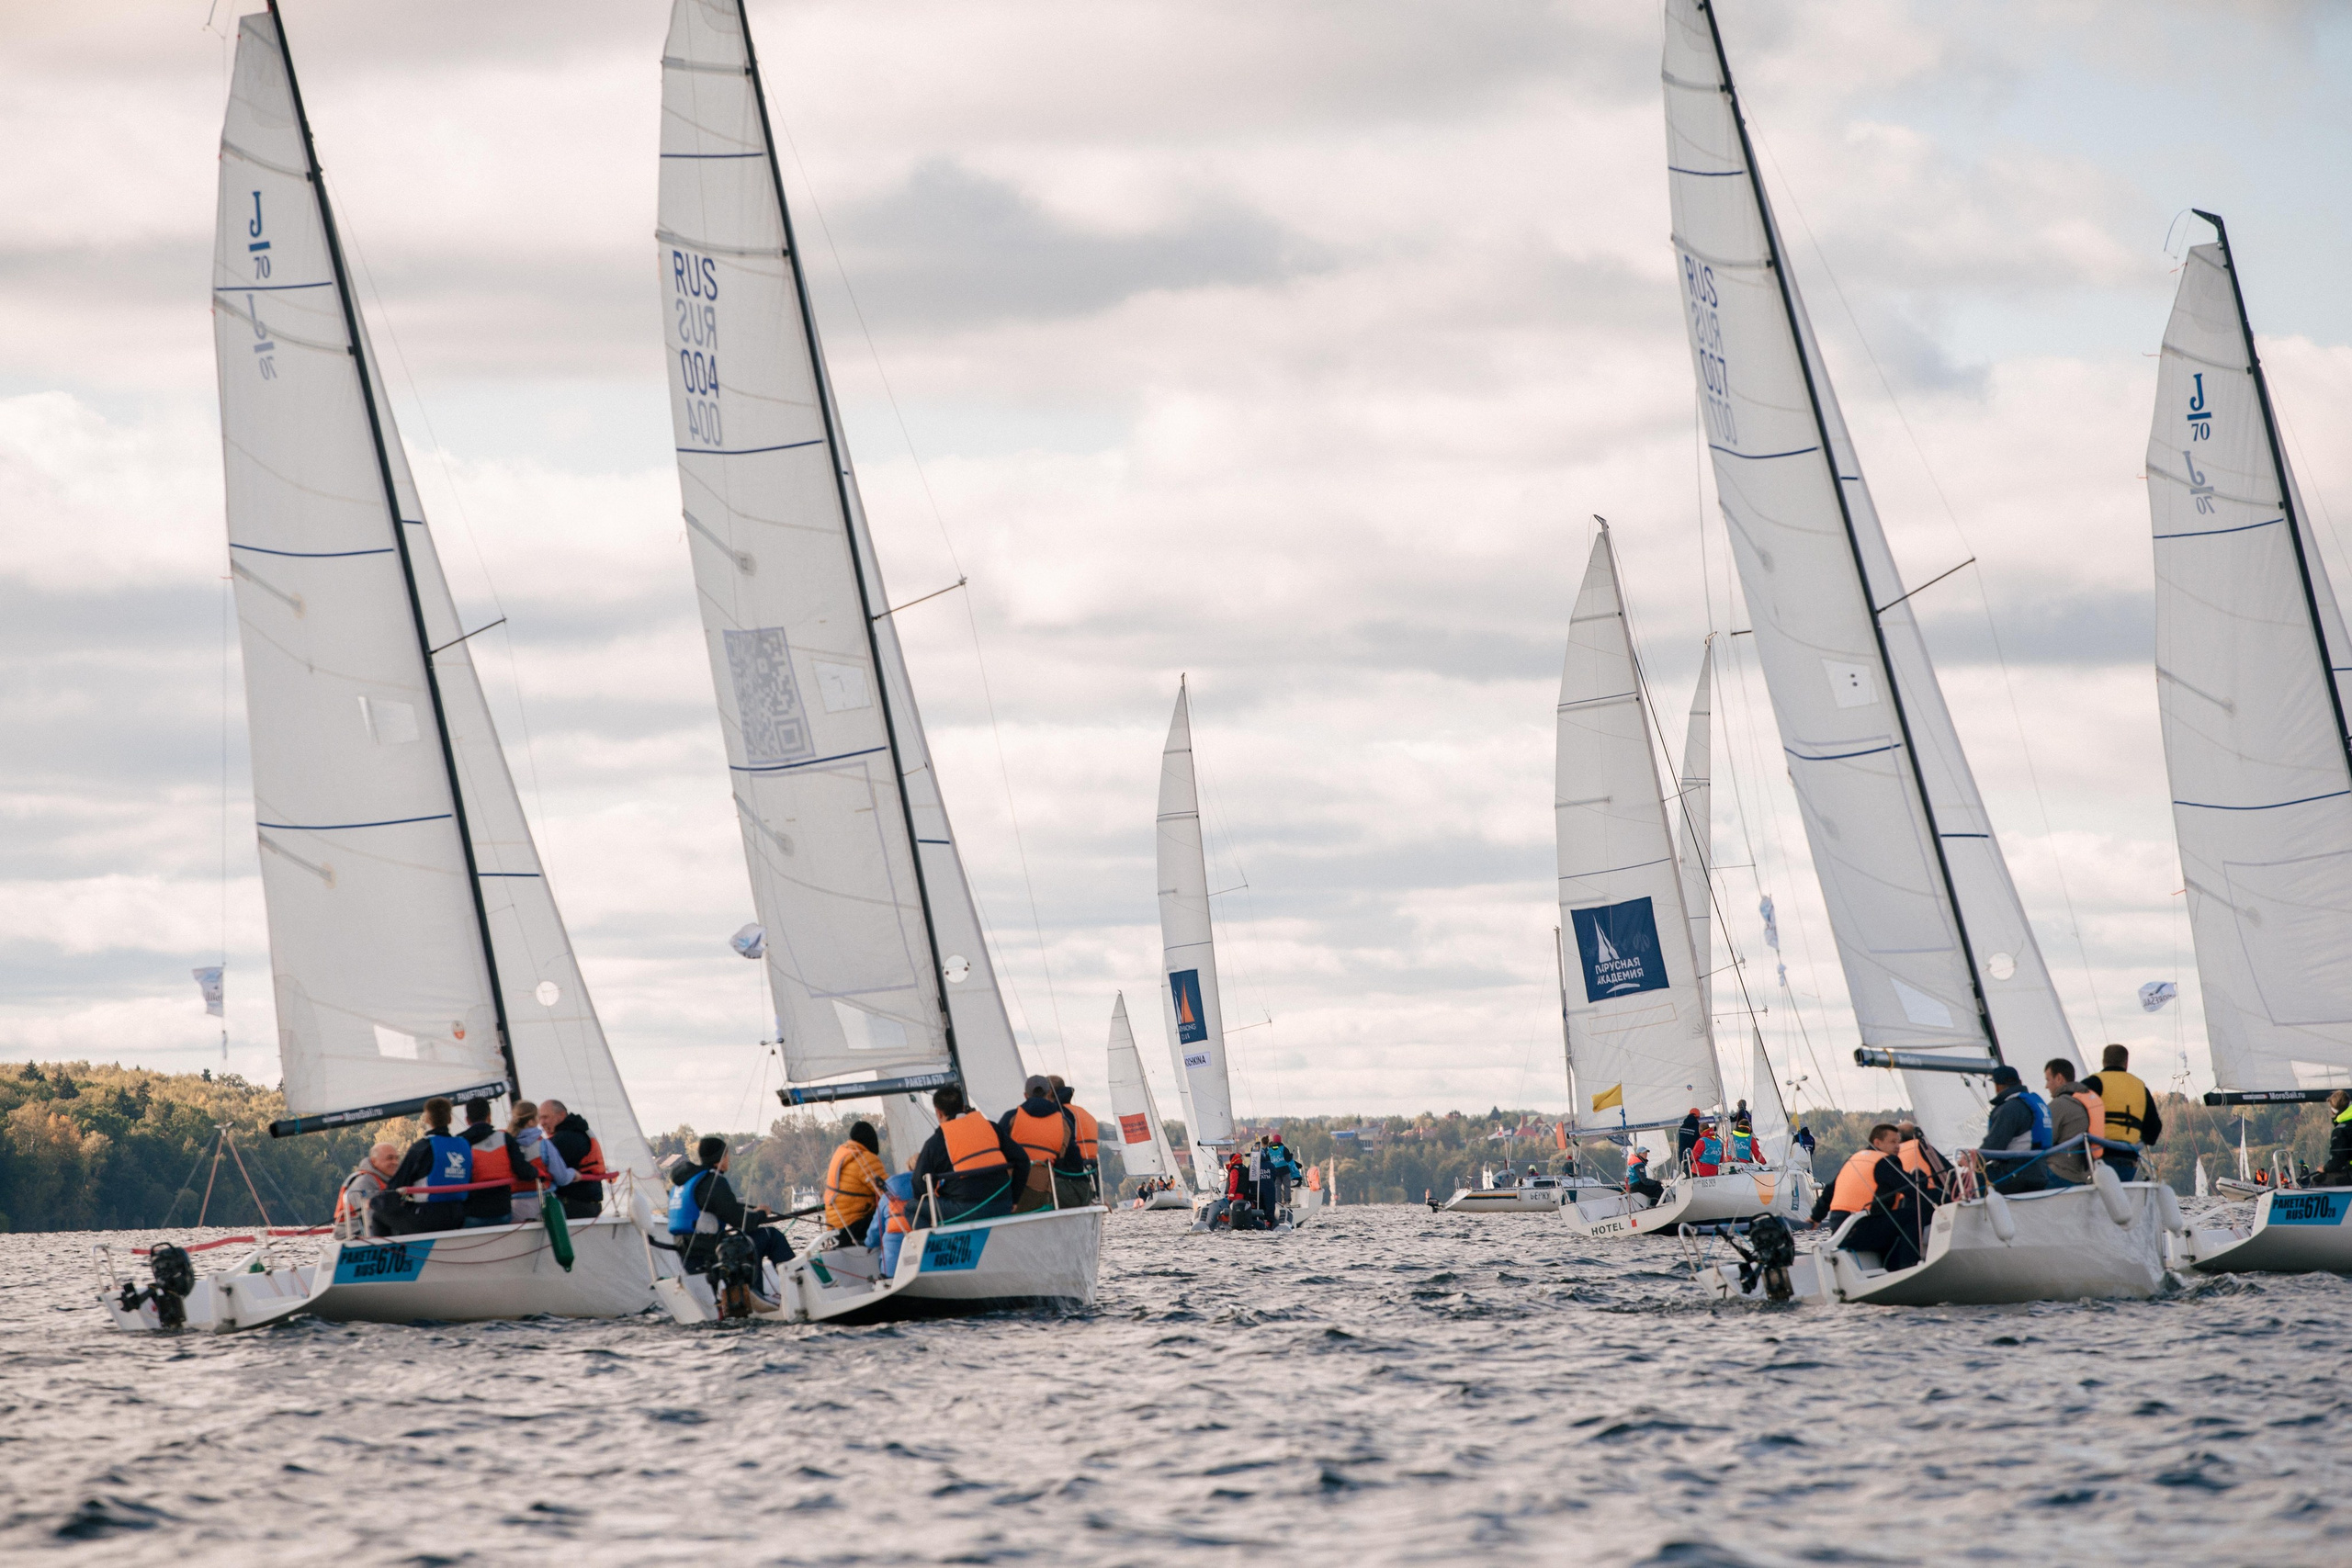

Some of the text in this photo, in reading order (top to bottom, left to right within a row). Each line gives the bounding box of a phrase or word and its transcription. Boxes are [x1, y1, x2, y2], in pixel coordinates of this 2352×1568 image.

[250, 191, 262, 238] J
[254, 255, 271, 280] 70
[673, 250, 718, 301] RUS
[1684, 254, 1718, 309] RUS
[680, 349, 719, 399] 004
[2189, 372, 2204, 412] J
[2191, 422, 2211, 442] 70
[1597, 967, 1645, 986] АКАДЕМИЯ
[2268, 1091, 2306, 1100] MoreSail.ru
[2285, 1209, 2304, 1221] RUS
[2304, 1195, 2329, 1219] 670
[1591, 1222, 1624, 1236] HOTEL
[377, 1245, 407, 1274] 670
[948, 1234, 971, 1265] 670
